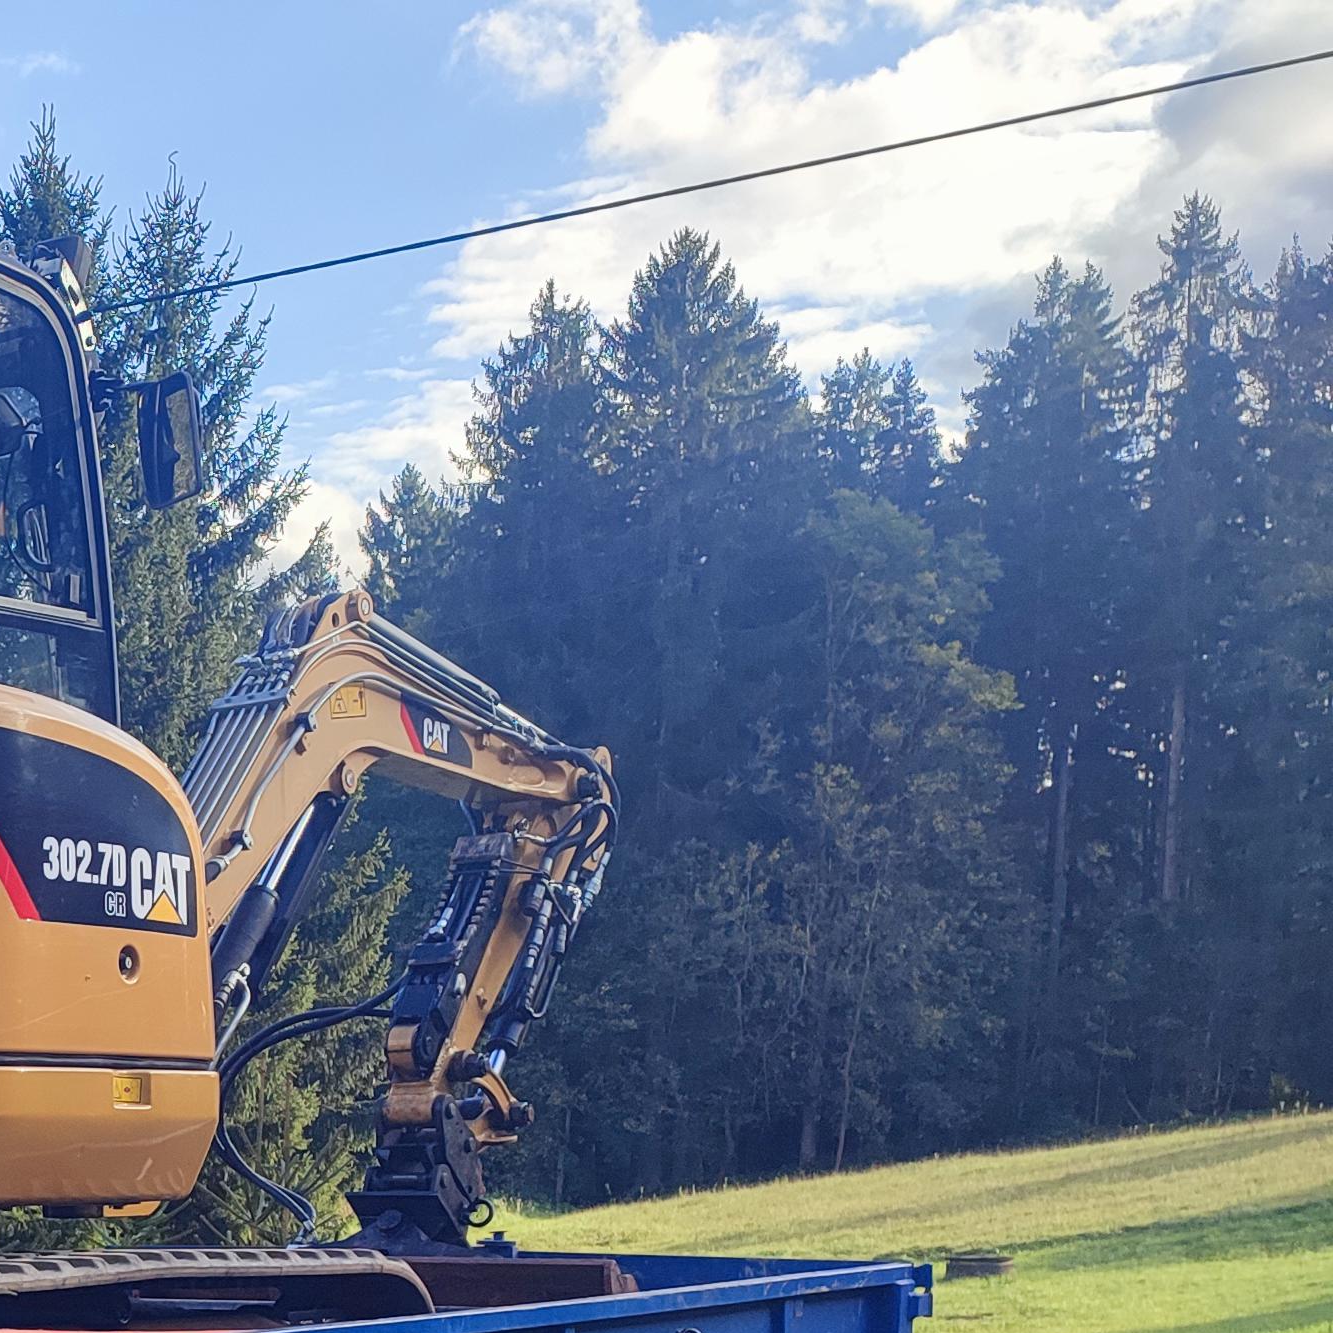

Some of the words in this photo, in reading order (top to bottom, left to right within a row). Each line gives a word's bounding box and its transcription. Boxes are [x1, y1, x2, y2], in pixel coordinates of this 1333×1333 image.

[423, 717, 450, 754] CAT
[42, 836, 127, 887] 302.7D
[104, 890, 126, 917] CR
[130, 847, 191, 926] CAT
